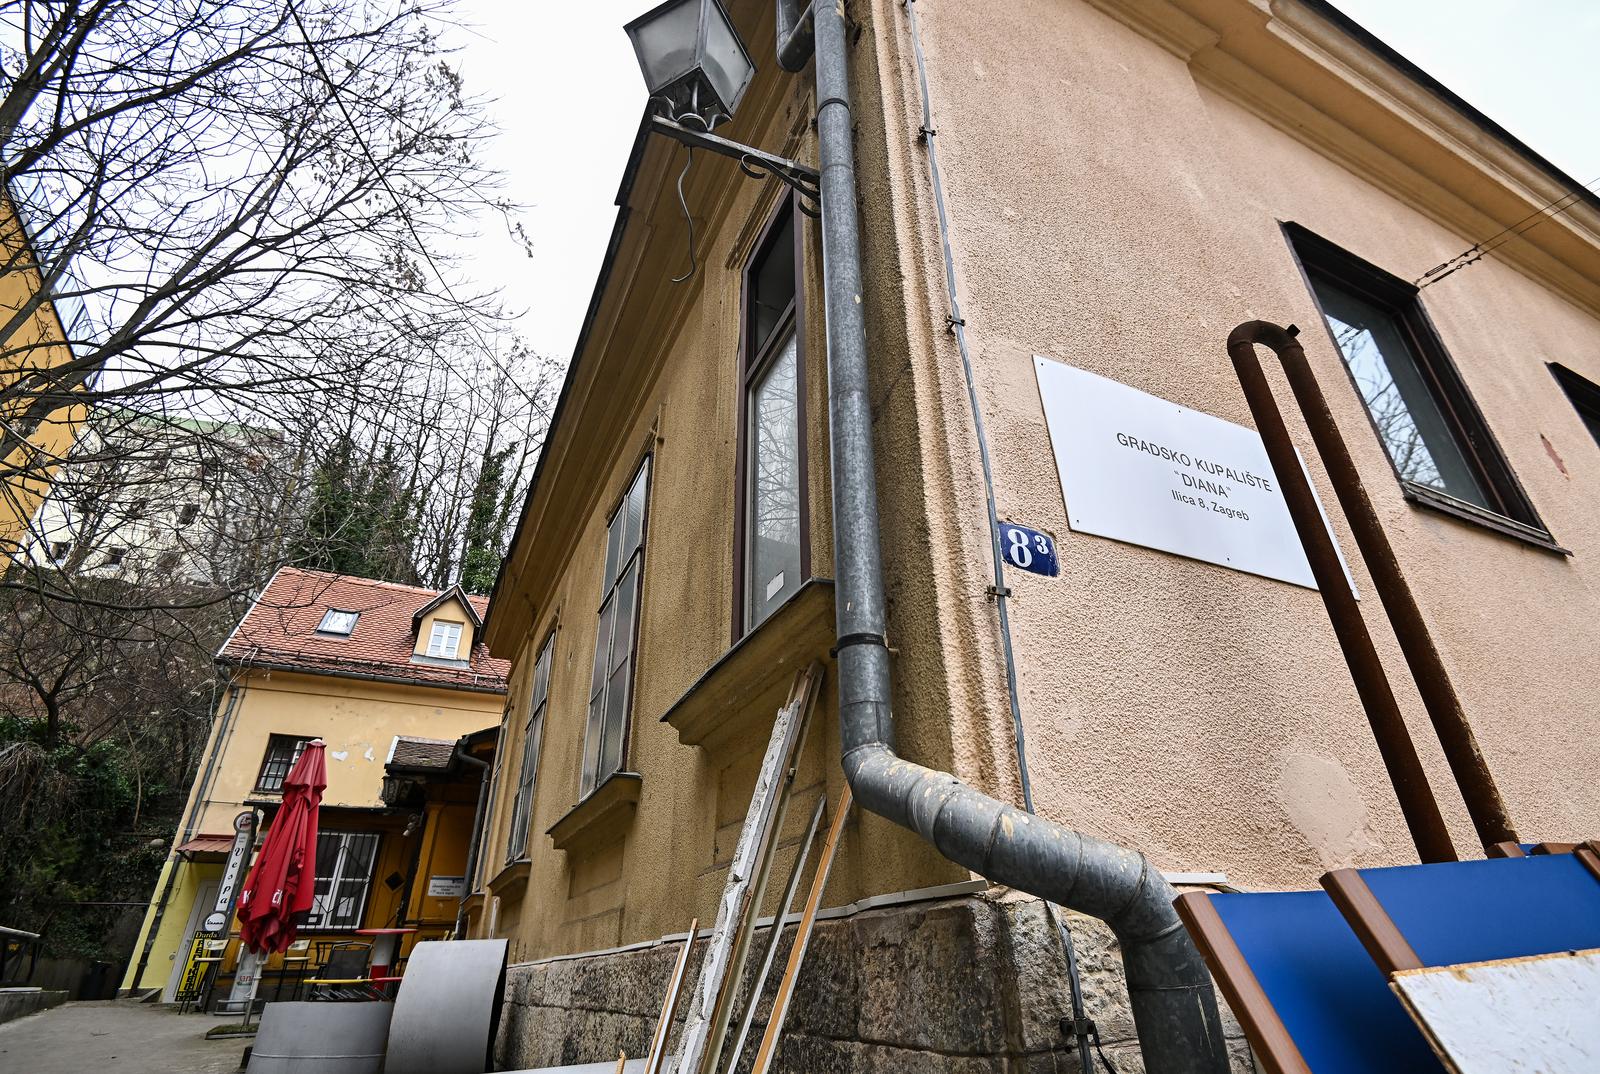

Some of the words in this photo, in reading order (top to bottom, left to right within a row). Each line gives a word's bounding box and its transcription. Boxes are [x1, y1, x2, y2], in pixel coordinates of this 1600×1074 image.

[1116, 432, 1191, 467] GRADSKO
[1194, 457, 1273, 493] KUPALIŠTE
[1171, 489, 1196, 507] Ilica
[1198, 497, 1210, 512] 8,
[1210, 501, 1250, 521] Zagreb
[219, 847, 245, 905] Vespa
